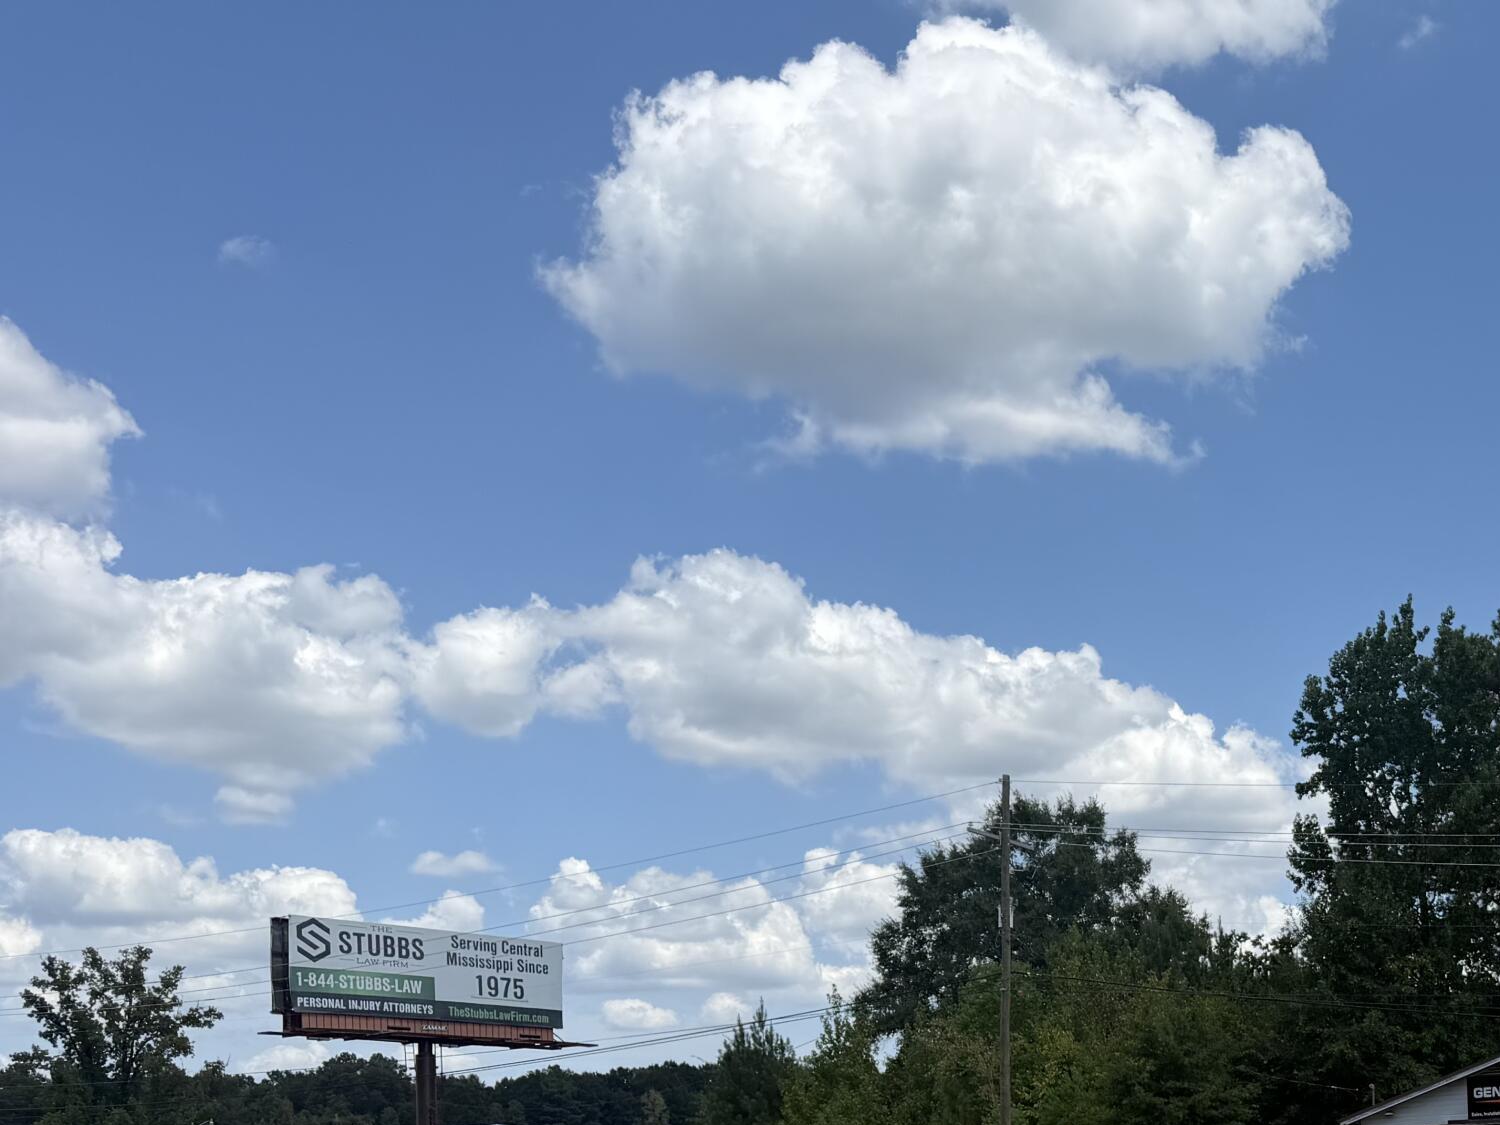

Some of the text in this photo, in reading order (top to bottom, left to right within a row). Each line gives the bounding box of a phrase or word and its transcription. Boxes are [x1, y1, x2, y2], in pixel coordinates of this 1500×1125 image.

[370, 925, 393, 934] THE
[339, 931, 425, 961] STUBBS
[451, 935, 543, 958] Serving Central
[356, 957, 409, 969] LAW FIRM
[446, 952, 549, 974] Mississippi Since
[296, 971, 423, 995] 1-844-STUBBS-LAW
[475, 975, 525, 1000] 1975
[297, 997, 434, 1015] PERSONAL INJURY ATTORNEYS
[448, 1006, 549, 1023] TheStubbsLawFirm.com
